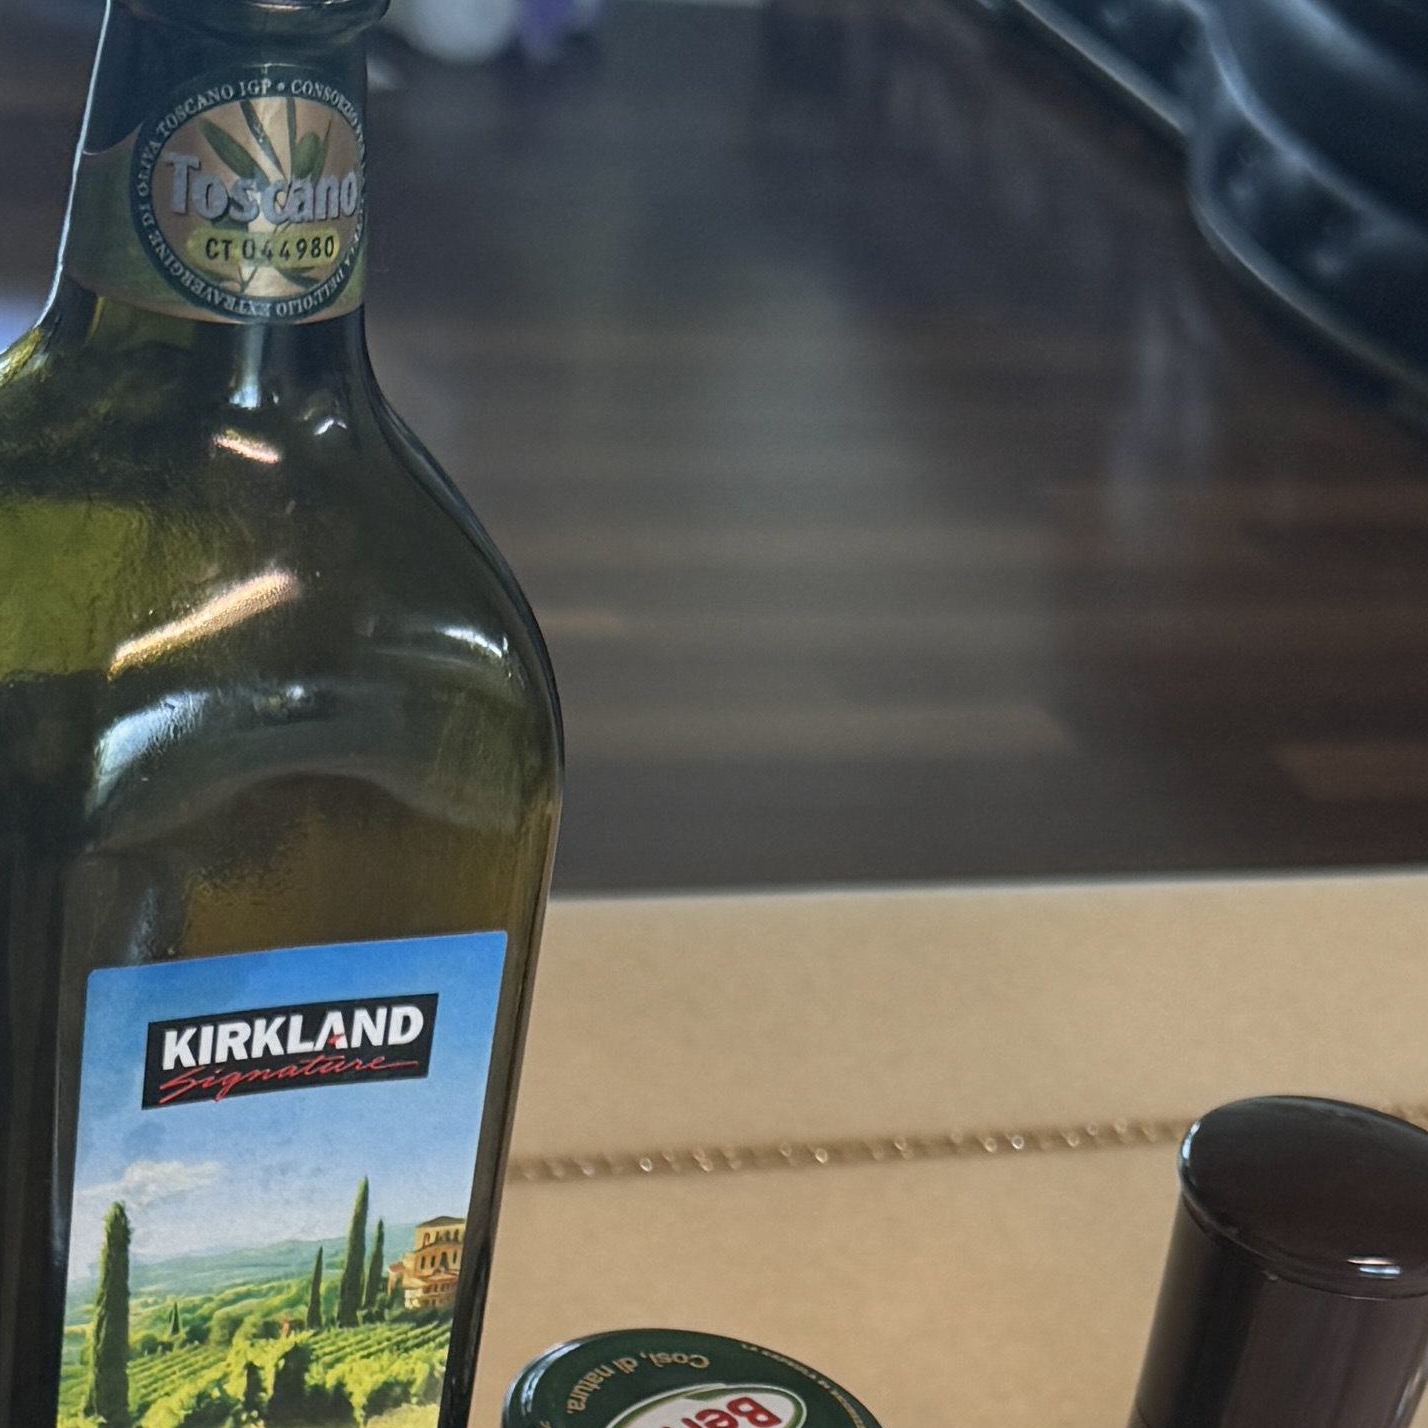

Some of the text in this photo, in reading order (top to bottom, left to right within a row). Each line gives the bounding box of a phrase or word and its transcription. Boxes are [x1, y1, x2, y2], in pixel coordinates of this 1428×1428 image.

[155, 85, 234, 138] TOSCANO
[240, 77, 273, 96] IGP
[136, 140, 161, 197] OLIVA
[164, 152, 359, 225] Toscano
[147, 229, 271, 317] EXTRAVERGINE
[205, 234, 335, 262] CT 044980
[162, 1003, 425, 1071] KIRKLAND
[158, 1055, 418, 1103] Signature
[610, 1356, 639, 1378] di
